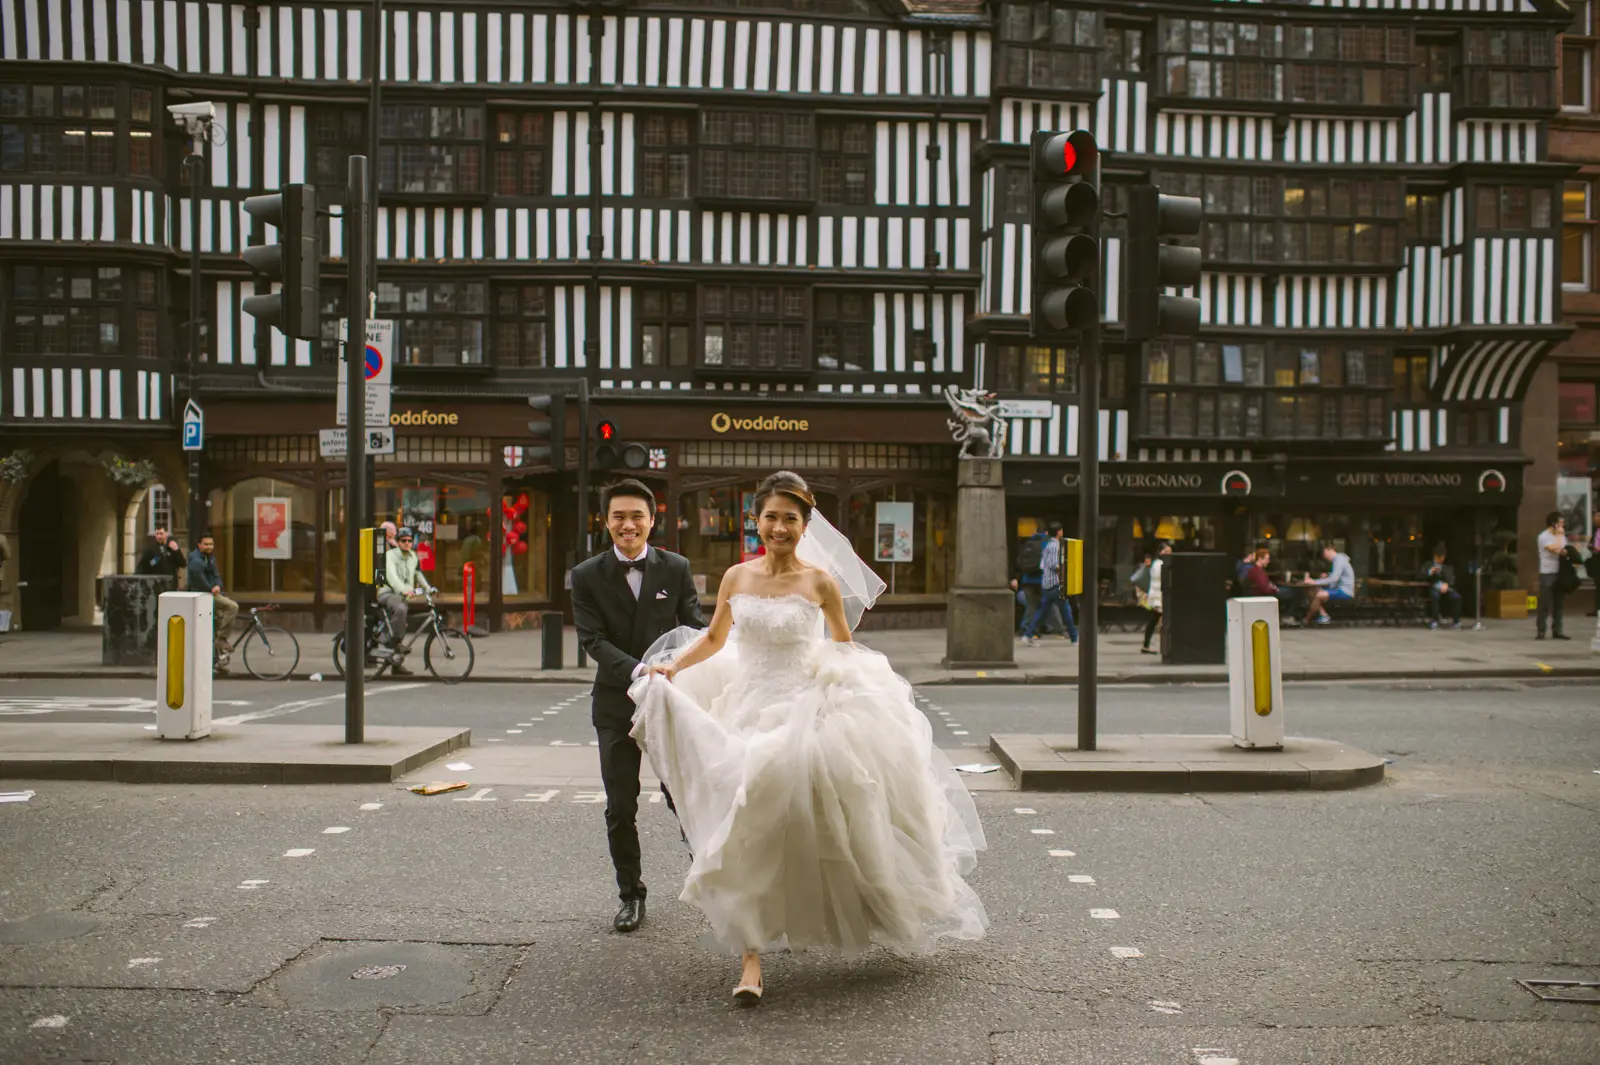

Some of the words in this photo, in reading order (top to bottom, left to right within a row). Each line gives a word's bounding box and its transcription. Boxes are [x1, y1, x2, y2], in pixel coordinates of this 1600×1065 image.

[365, 332, 382, 342] NE
[390, 410, 458, 425] odafone
[732, 416, 809, 431] vodafone
[186, 424, 196, 443] P
[1116, 473, 1202, 488] VERGNANO
[1384, 472, 1461, 487] VERGNANO
